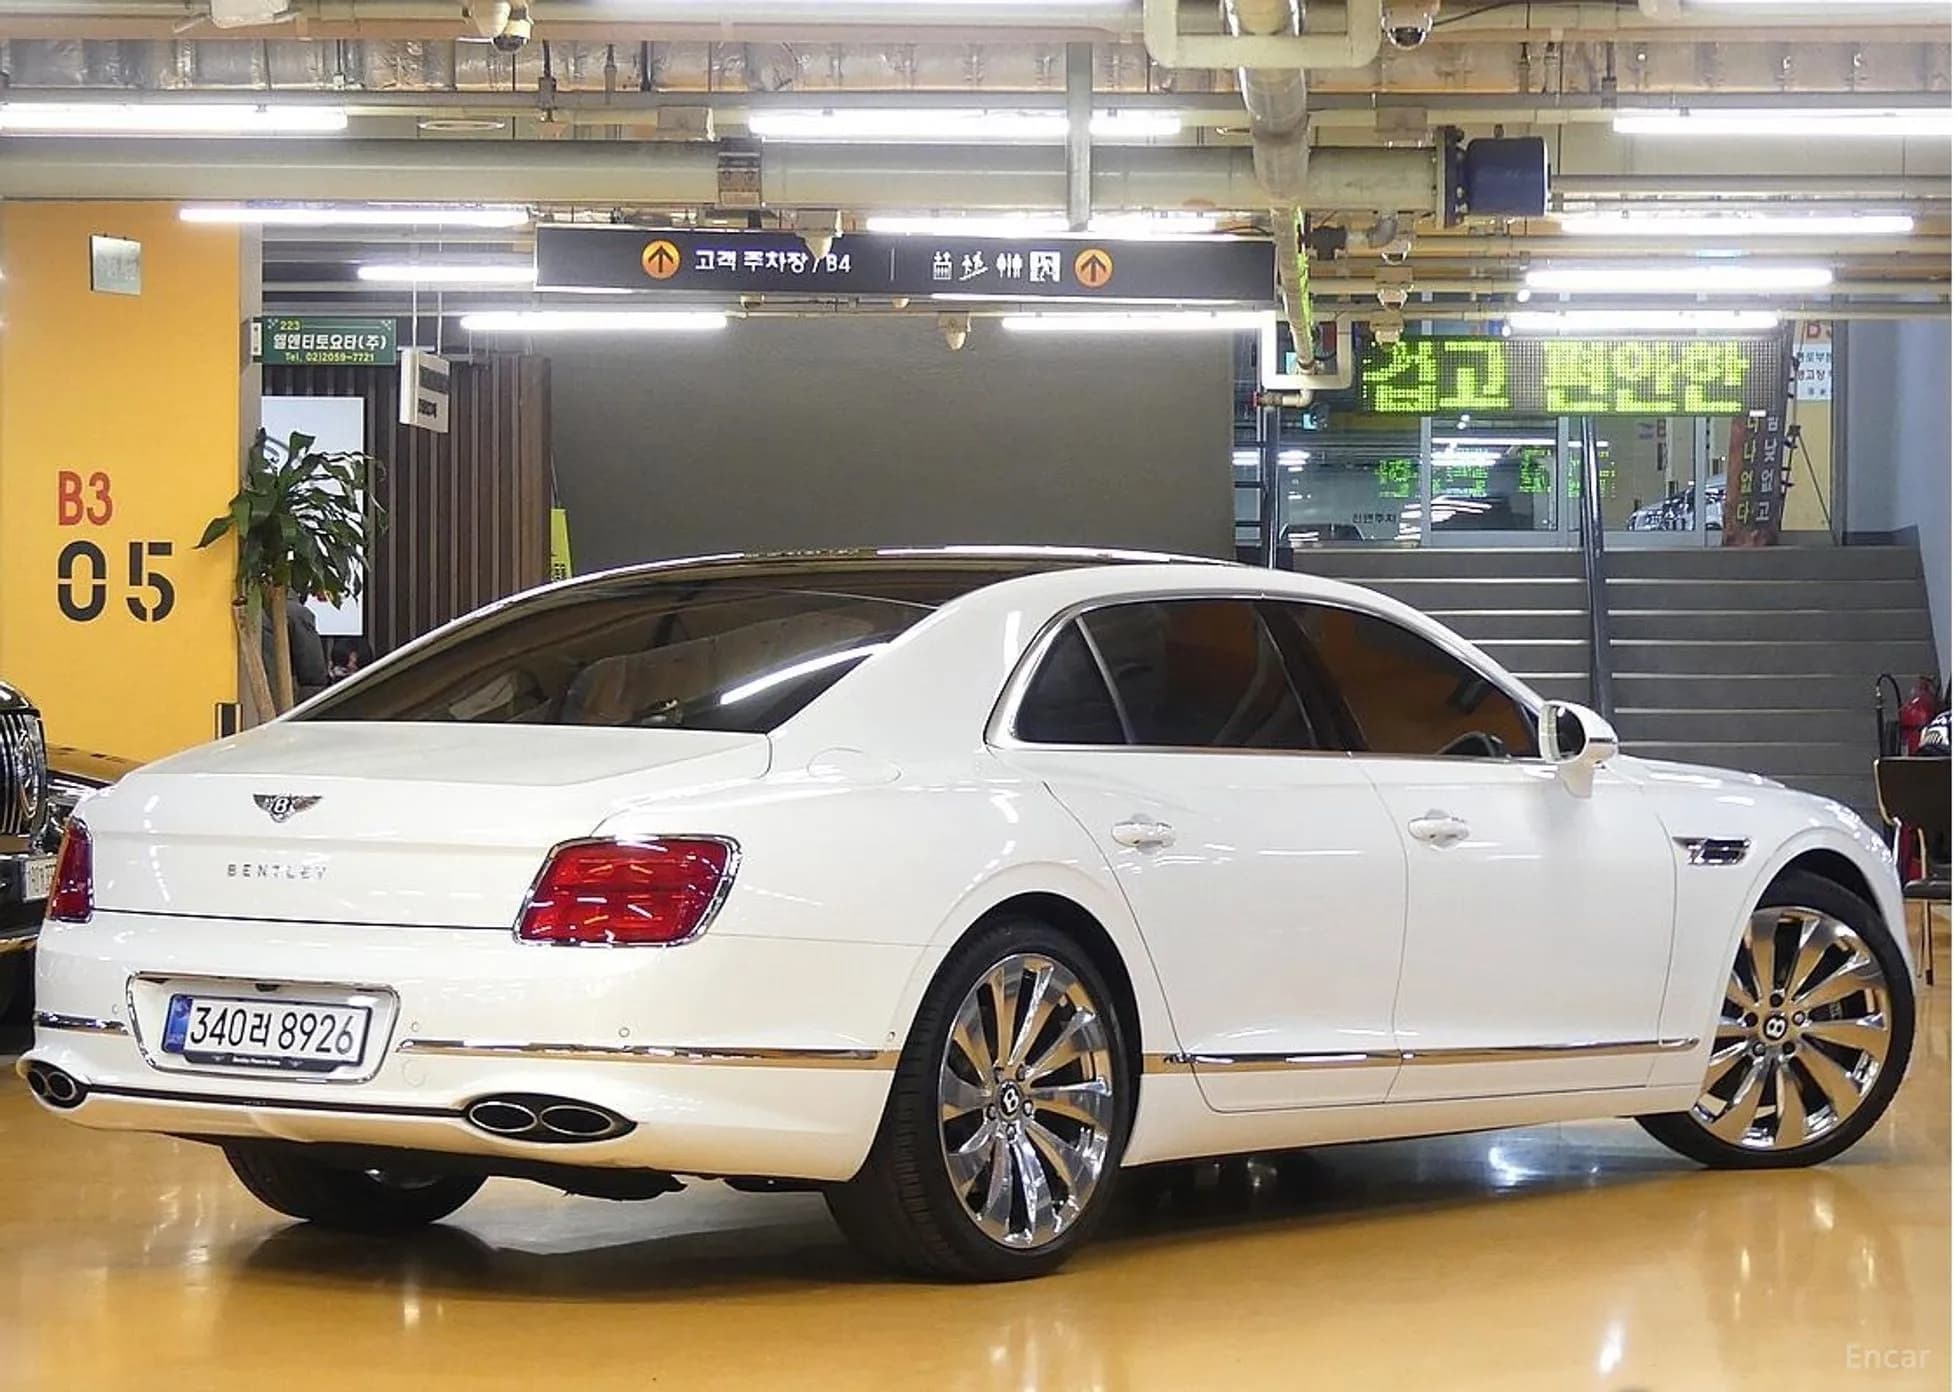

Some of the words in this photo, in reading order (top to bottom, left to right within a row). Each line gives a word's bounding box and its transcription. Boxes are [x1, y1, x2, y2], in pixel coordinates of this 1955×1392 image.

[695, 249, 737, 272] 고객
[743, 249, 809, 273] 주차장
[279, 320, 301, 331] 223
[58, 470, 114, 527] B3
[57, 539, 176, 623] 05
[227, 863, 328, 881] BENTLEY
[190, 1006, 272, 1047] 340러
[278, 1012, 355, 1055] 8926
